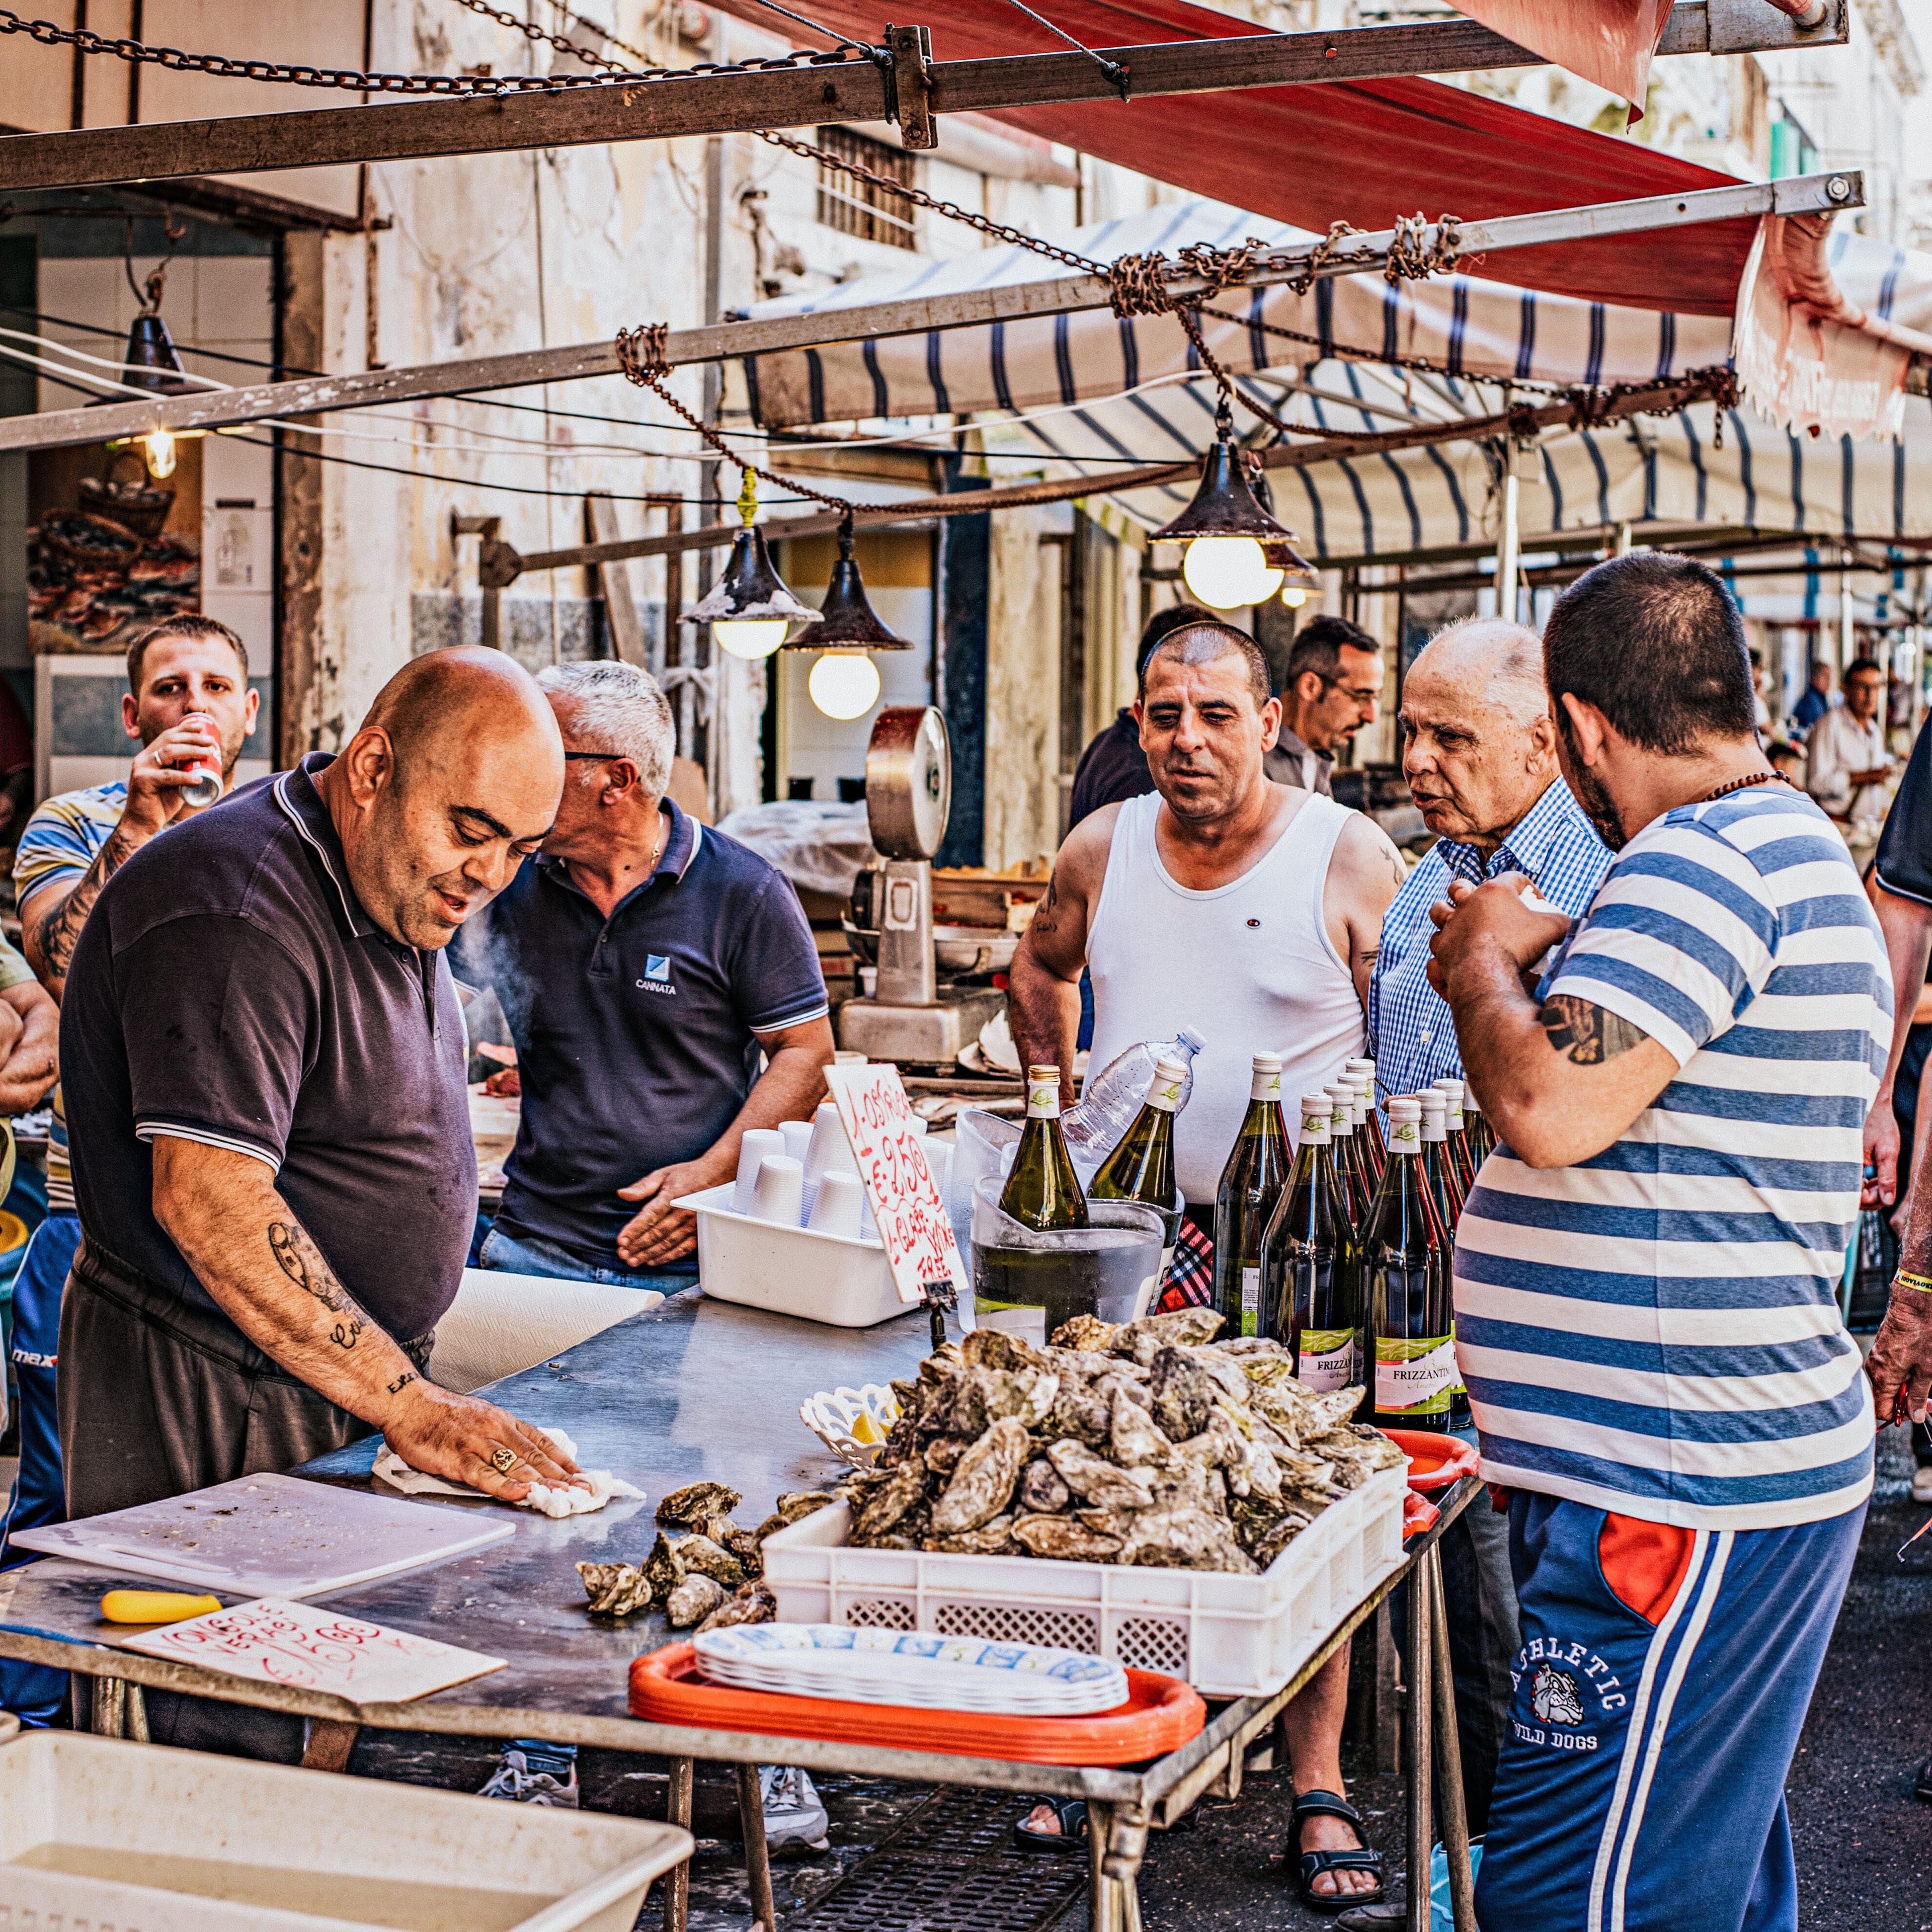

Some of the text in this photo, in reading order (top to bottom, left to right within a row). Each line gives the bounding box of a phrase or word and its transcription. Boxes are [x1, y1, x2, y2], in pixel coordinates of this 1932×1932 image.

[636, 979, 676, 995] CANNATA
[1510, 1637, 1627, 1710] ATHLETIC
[1551, 1732, 1598, 1750] DOGS
